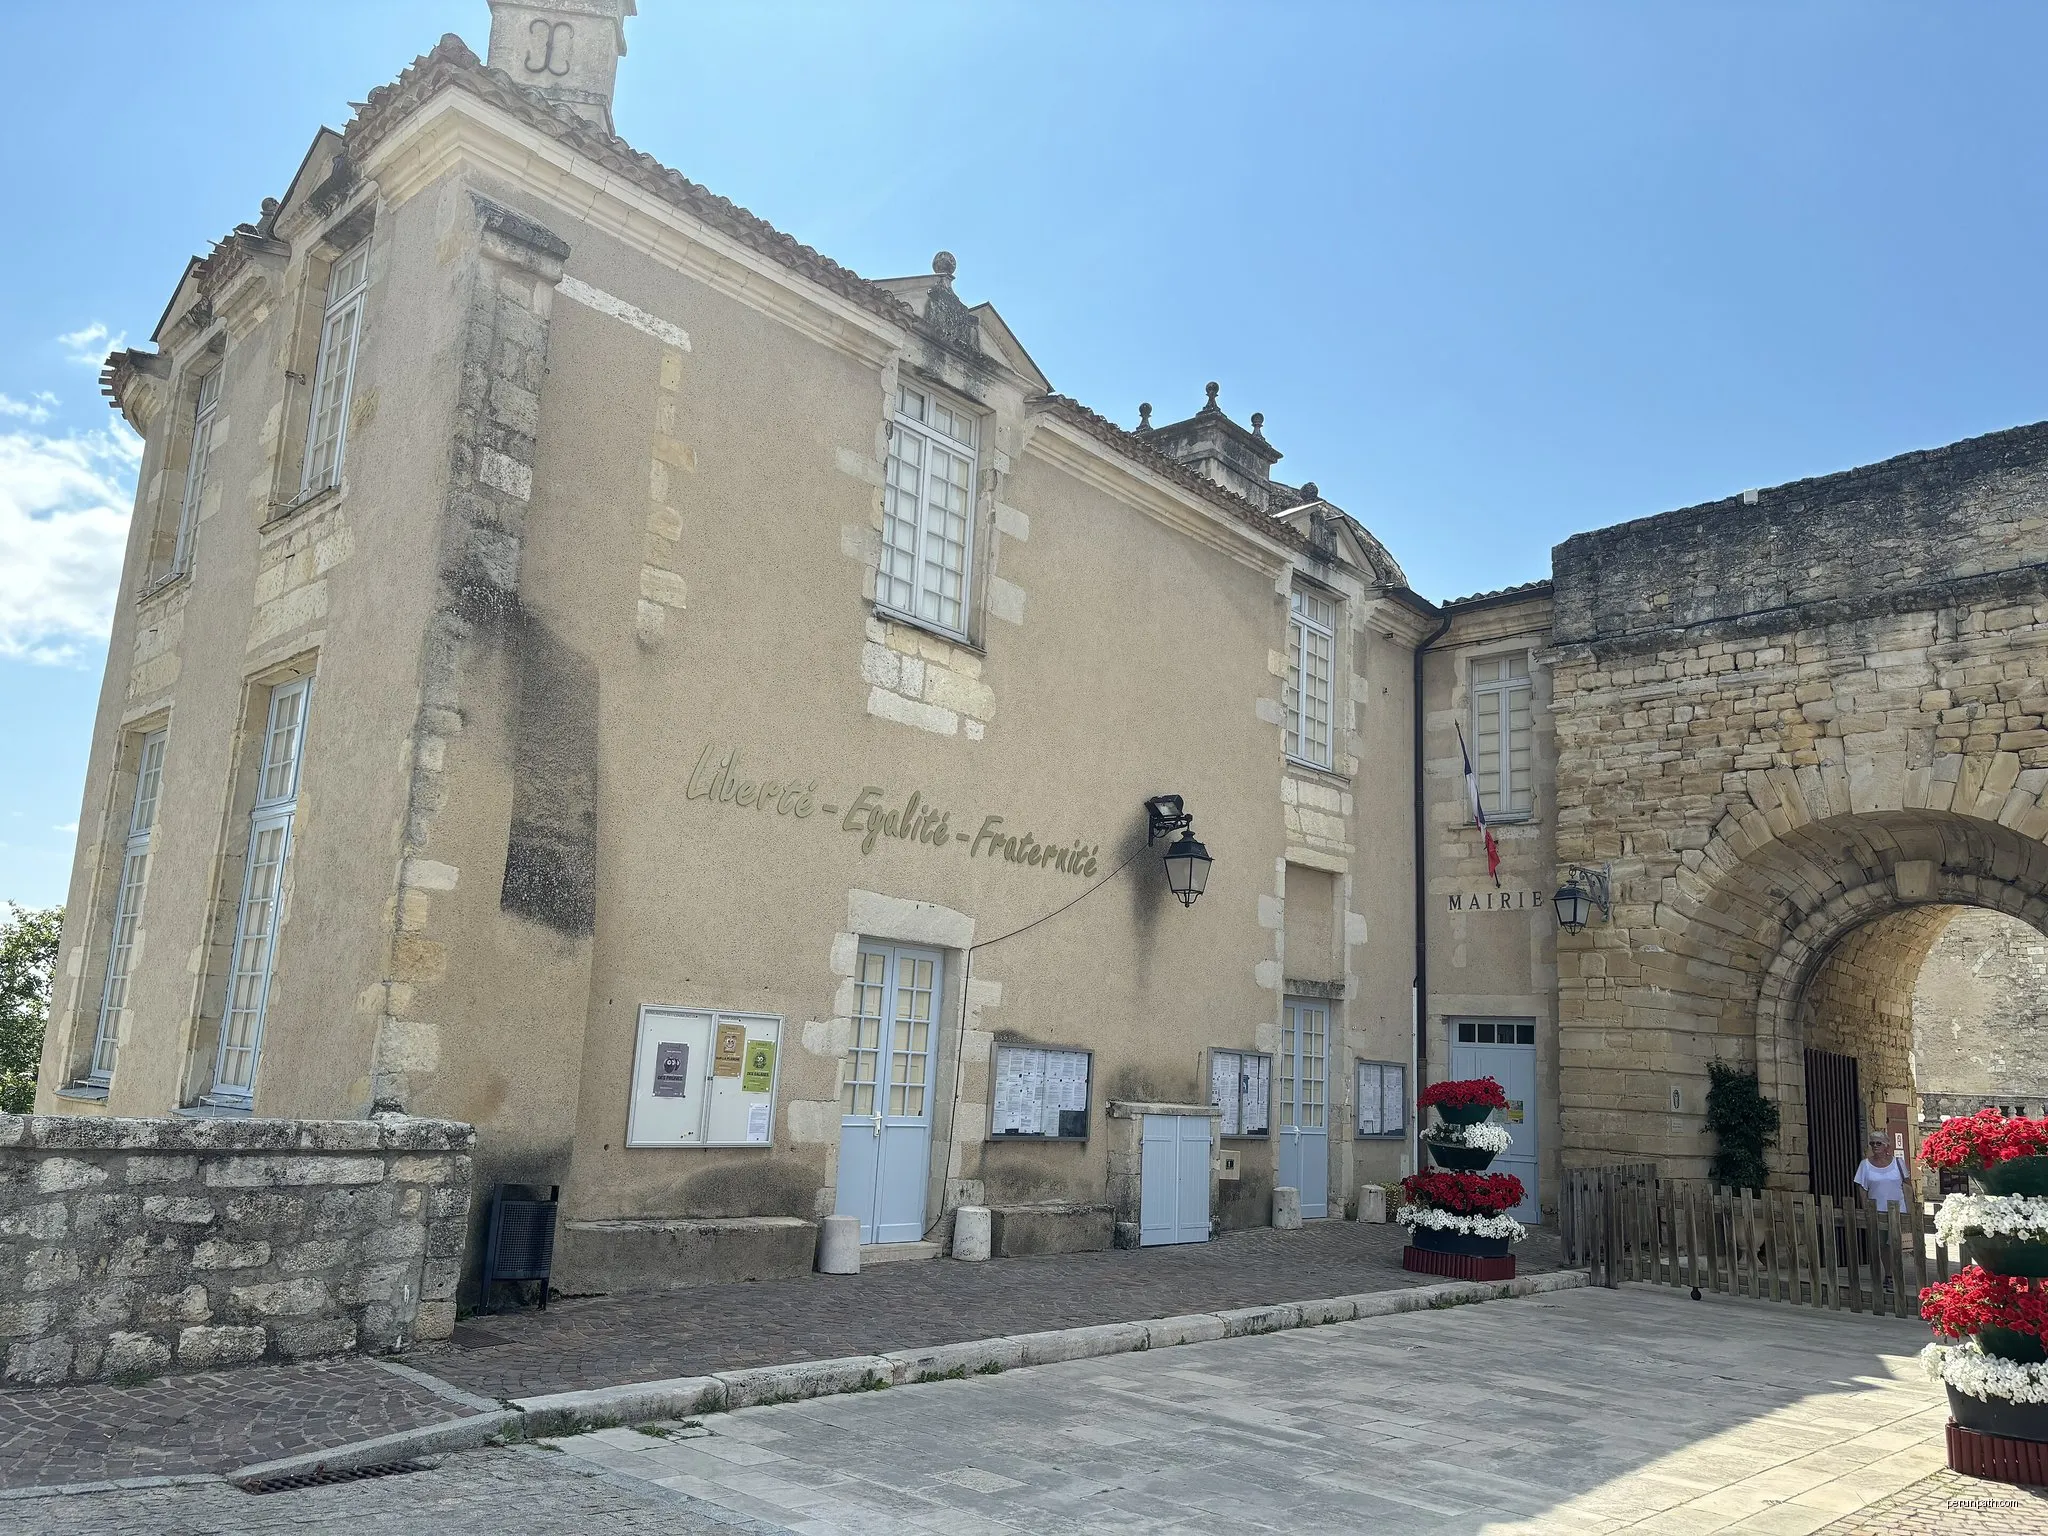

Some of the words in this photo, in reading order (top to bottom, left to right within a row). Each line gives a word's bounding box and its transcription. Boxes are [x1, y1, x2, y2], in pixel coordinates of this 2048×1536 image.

[686, 743, 816, 818] Liberté
[842, 786, 950, 855] Egalité
[970, 815, 1099, 877] Fraternité
[1449, 891, 1543, 910] MAIRIE
